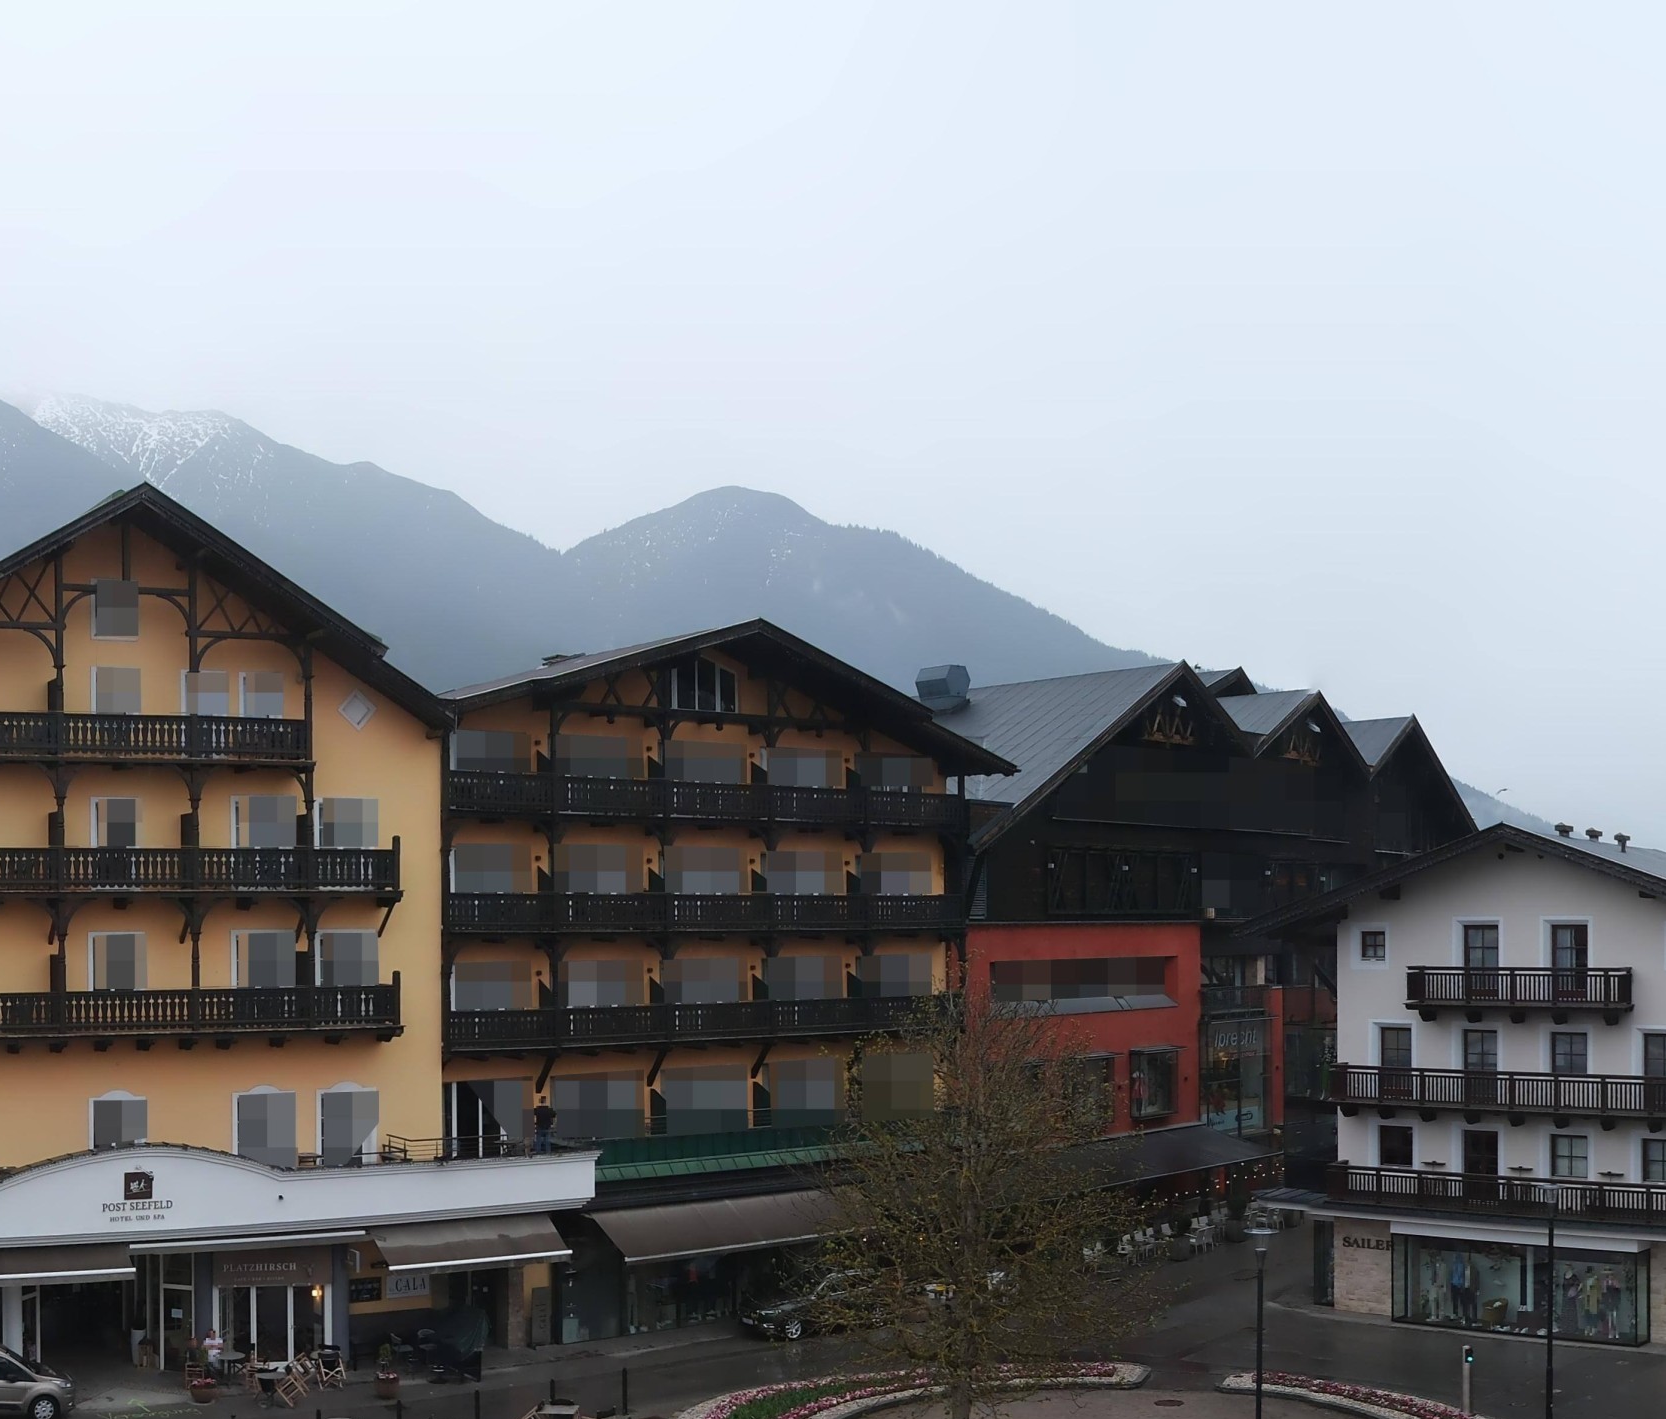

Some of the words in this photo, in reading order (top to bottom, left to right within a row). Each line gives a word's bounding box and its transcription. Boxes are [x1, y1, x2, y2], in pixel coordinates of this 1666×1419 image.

[102, 1202, 127, 1212] POST
[130, 1200, 173, 1211] SEEFELD
[223, 1262, 297, 1272] PLATZHIRSCH
[395, 1276, 426, 1292] CALA
